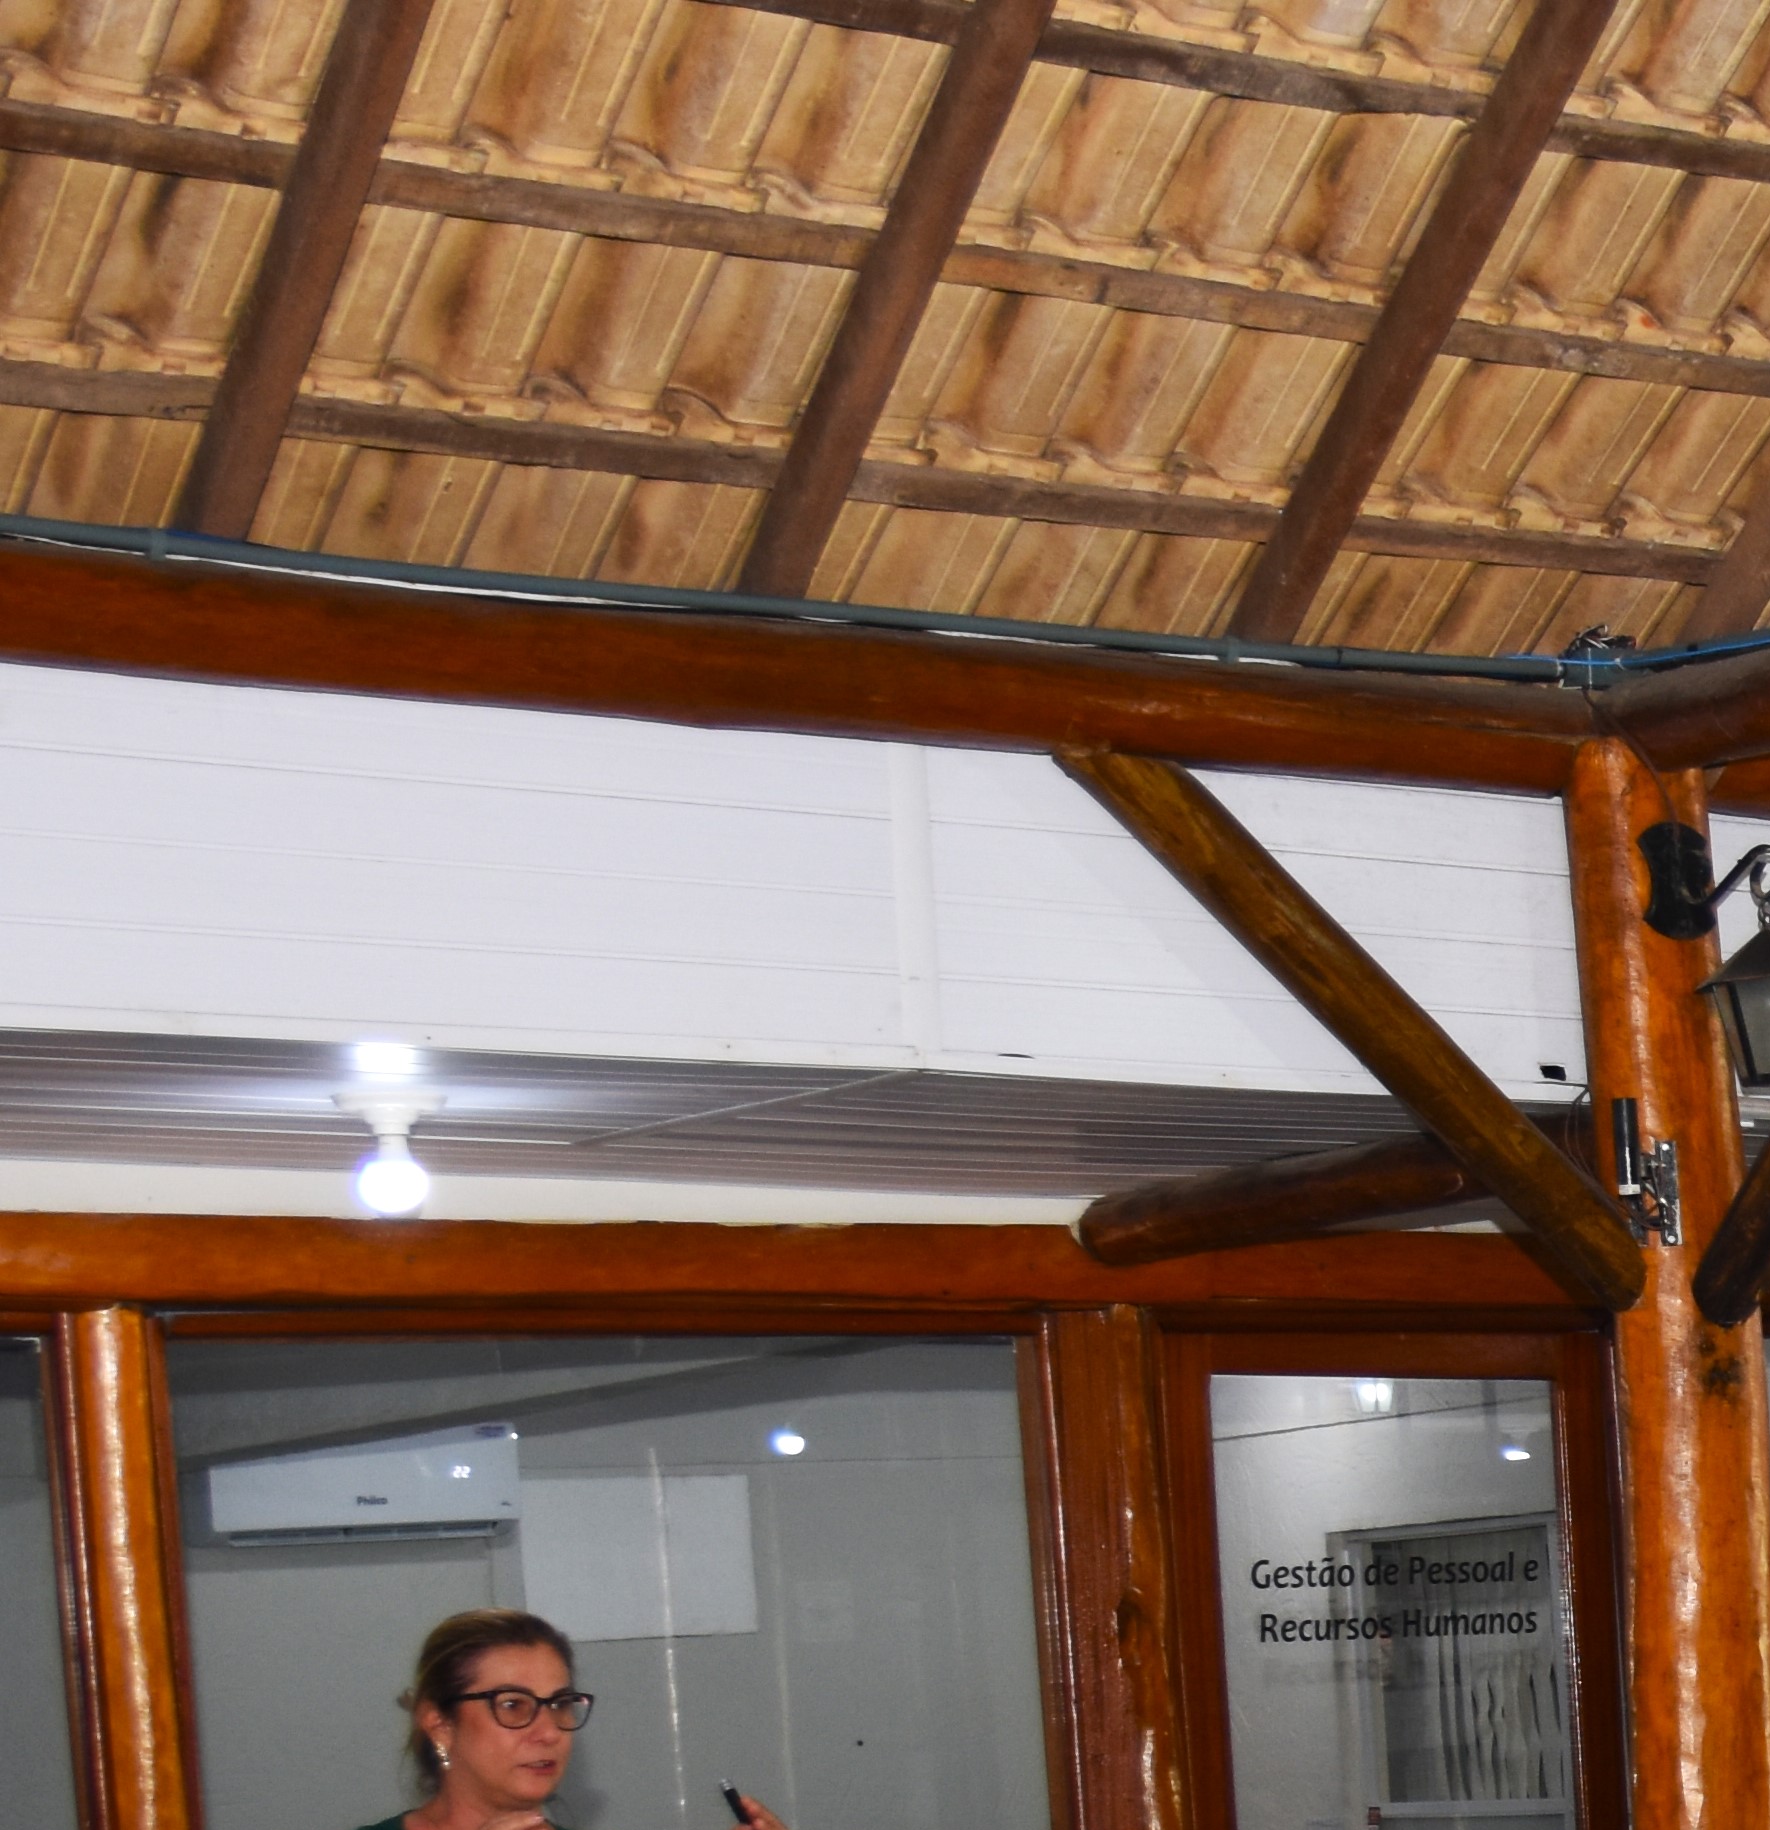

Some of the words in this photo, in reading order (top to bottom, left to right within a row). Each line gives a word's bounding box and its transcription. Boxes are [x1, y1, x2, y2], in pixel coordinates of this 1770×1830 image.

[452, 1465, 471, 1479] 22
[1251, 1556, 1355, 1590] Gestão
[1364, 1555, 1399, 1586] de
[1409, 1552, 1515, 1585] Pessoal
[1524, 1558, 1539, 1582] e
[1260, 1613, 1393, 1643] Recursos
[1402, 1608, 1538, 1638] Humanos
